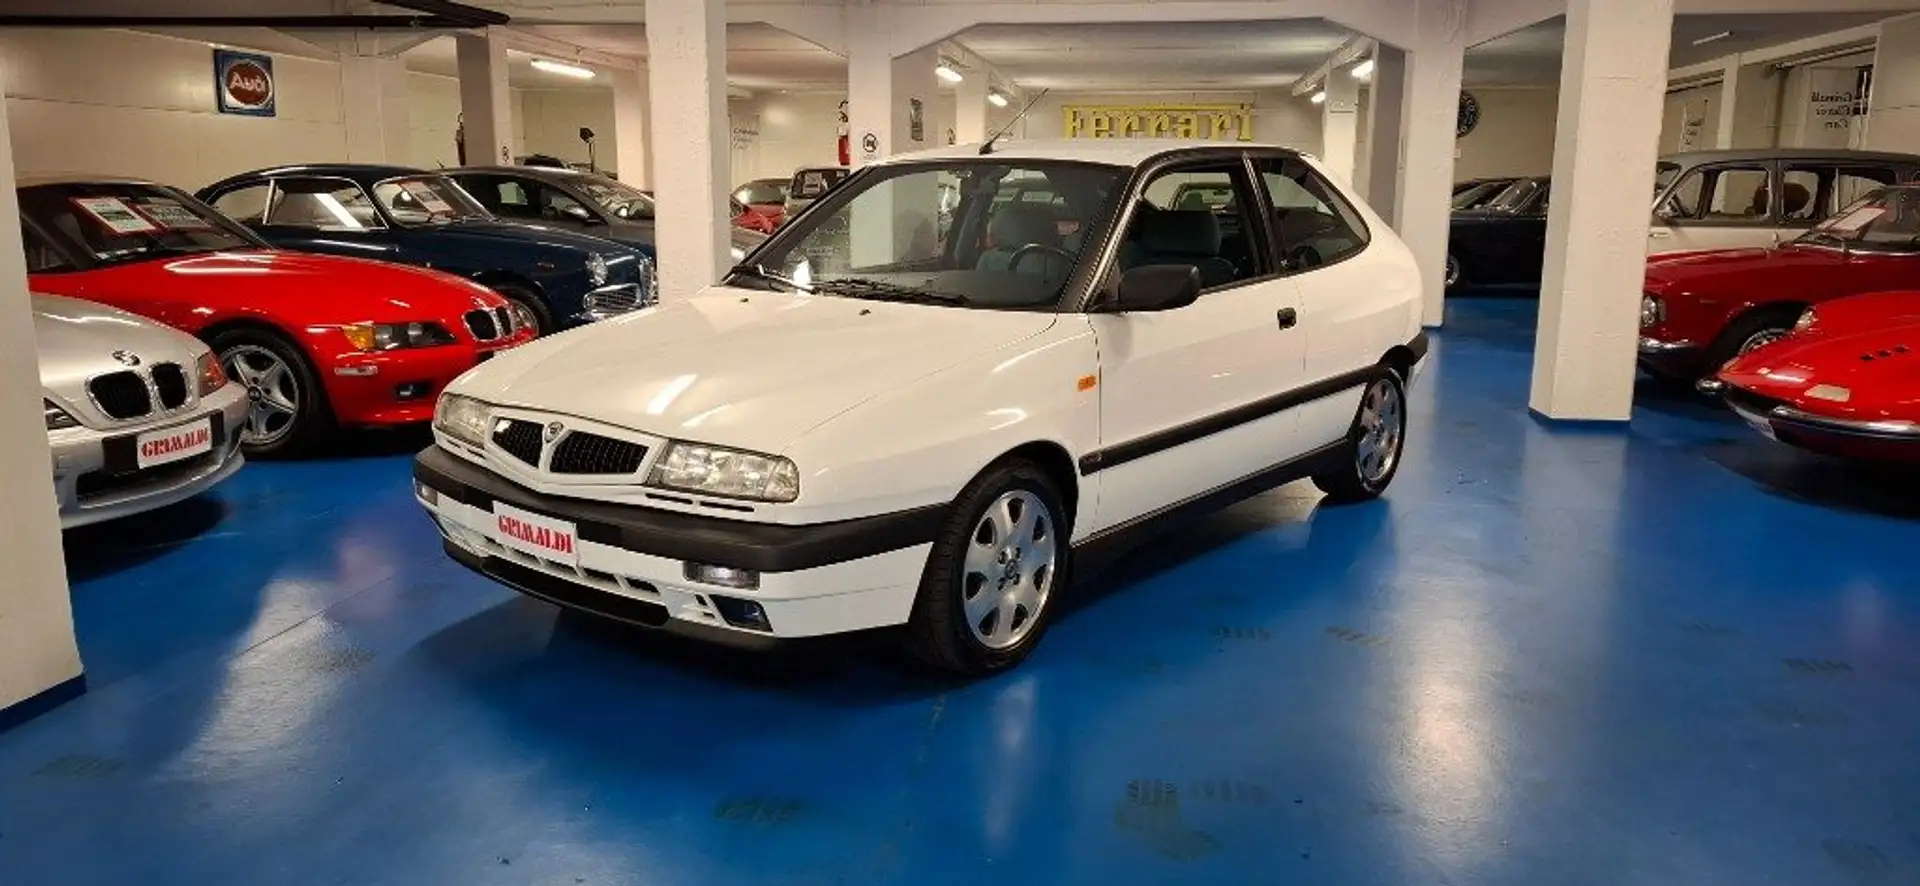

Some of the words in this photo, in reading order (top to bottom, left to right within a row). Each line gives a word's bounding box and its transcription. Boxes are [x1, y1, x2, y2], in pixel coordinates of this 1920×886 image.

[1062, 104, 1254, 142] Ferrari
[141, 427, 208, 457] GRIMALDI
[498, 515, 572, 553] GRIMALDI
